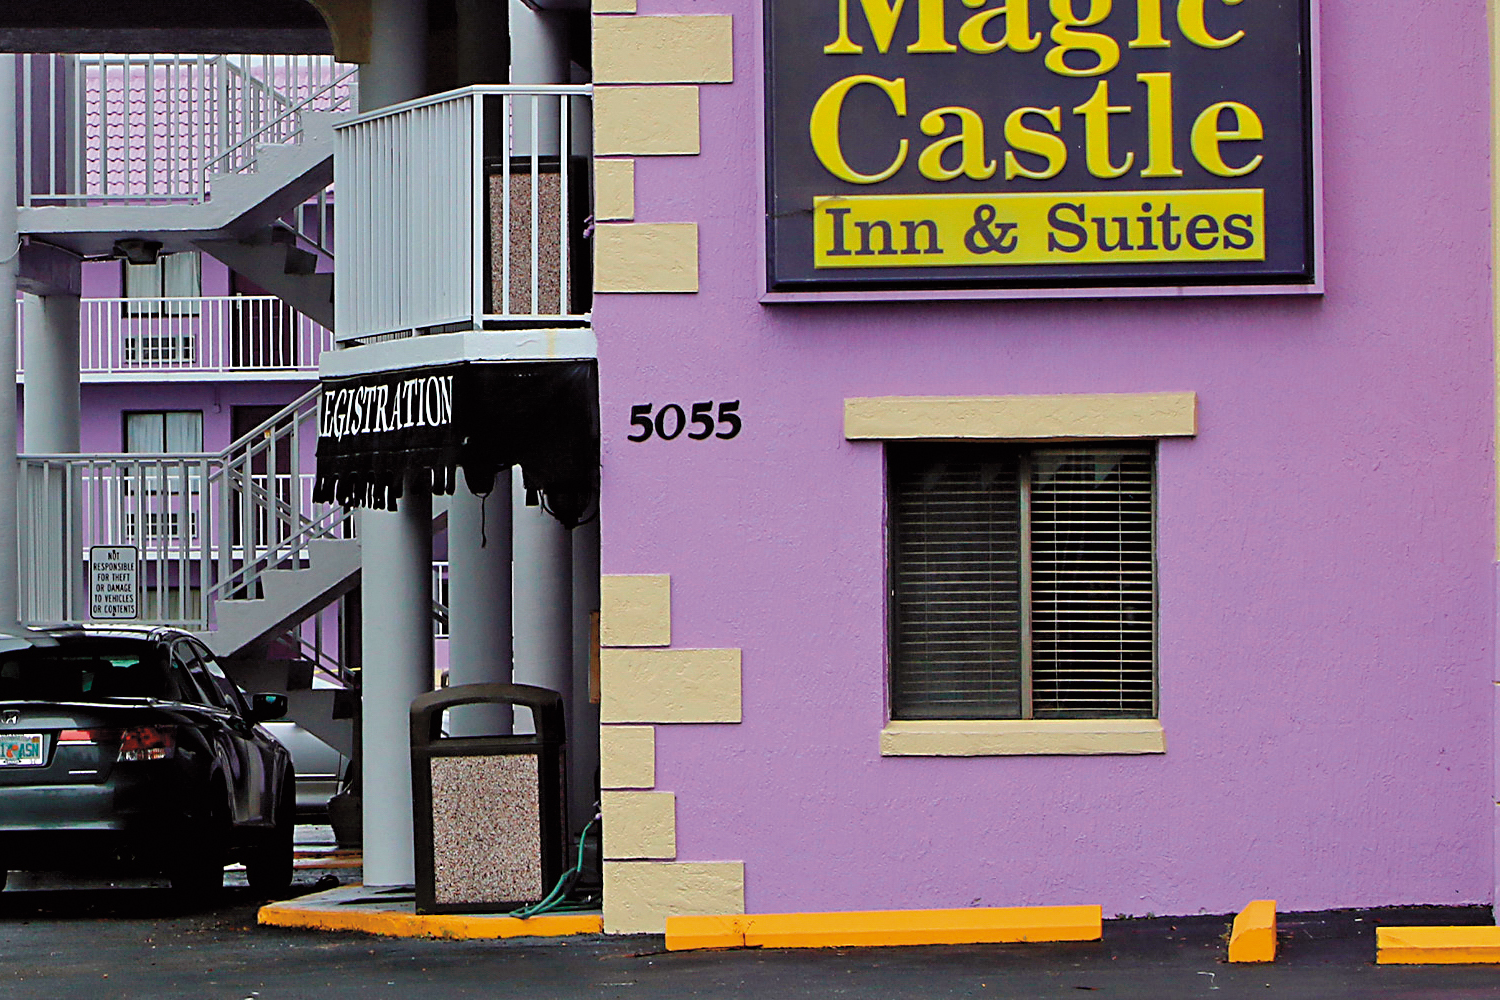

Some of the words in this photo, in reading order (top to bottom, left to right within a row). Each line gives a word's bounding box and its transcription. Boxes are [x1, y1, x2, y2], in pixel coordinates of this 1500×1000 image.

[809, 71, 1265, 185] Castle
[824, 206, 944, 257] Inn
[963, 203, 1019, 255] &
[1046, 201, 1255, 253] Suites
[319, 375, 454, 443] EGISTRATION
[626, 399, 742, 443] 5055
[108, 552, 120, 560] NOT
[93, 562, 134, 571] RESPONSIBLE
[97, 573, 109, 581] FOR
[112, 573, 130, 581] THEFT
[96, 584, 105, 592] OR
[107, 584, 132, 592] DAMAGE
[94, 594, 102, 603] TO
[104, 594, 134, 603] VEHICLES
[93, 605, 102, 613] OR
[104, 605, 135, 613] CONTENTS
